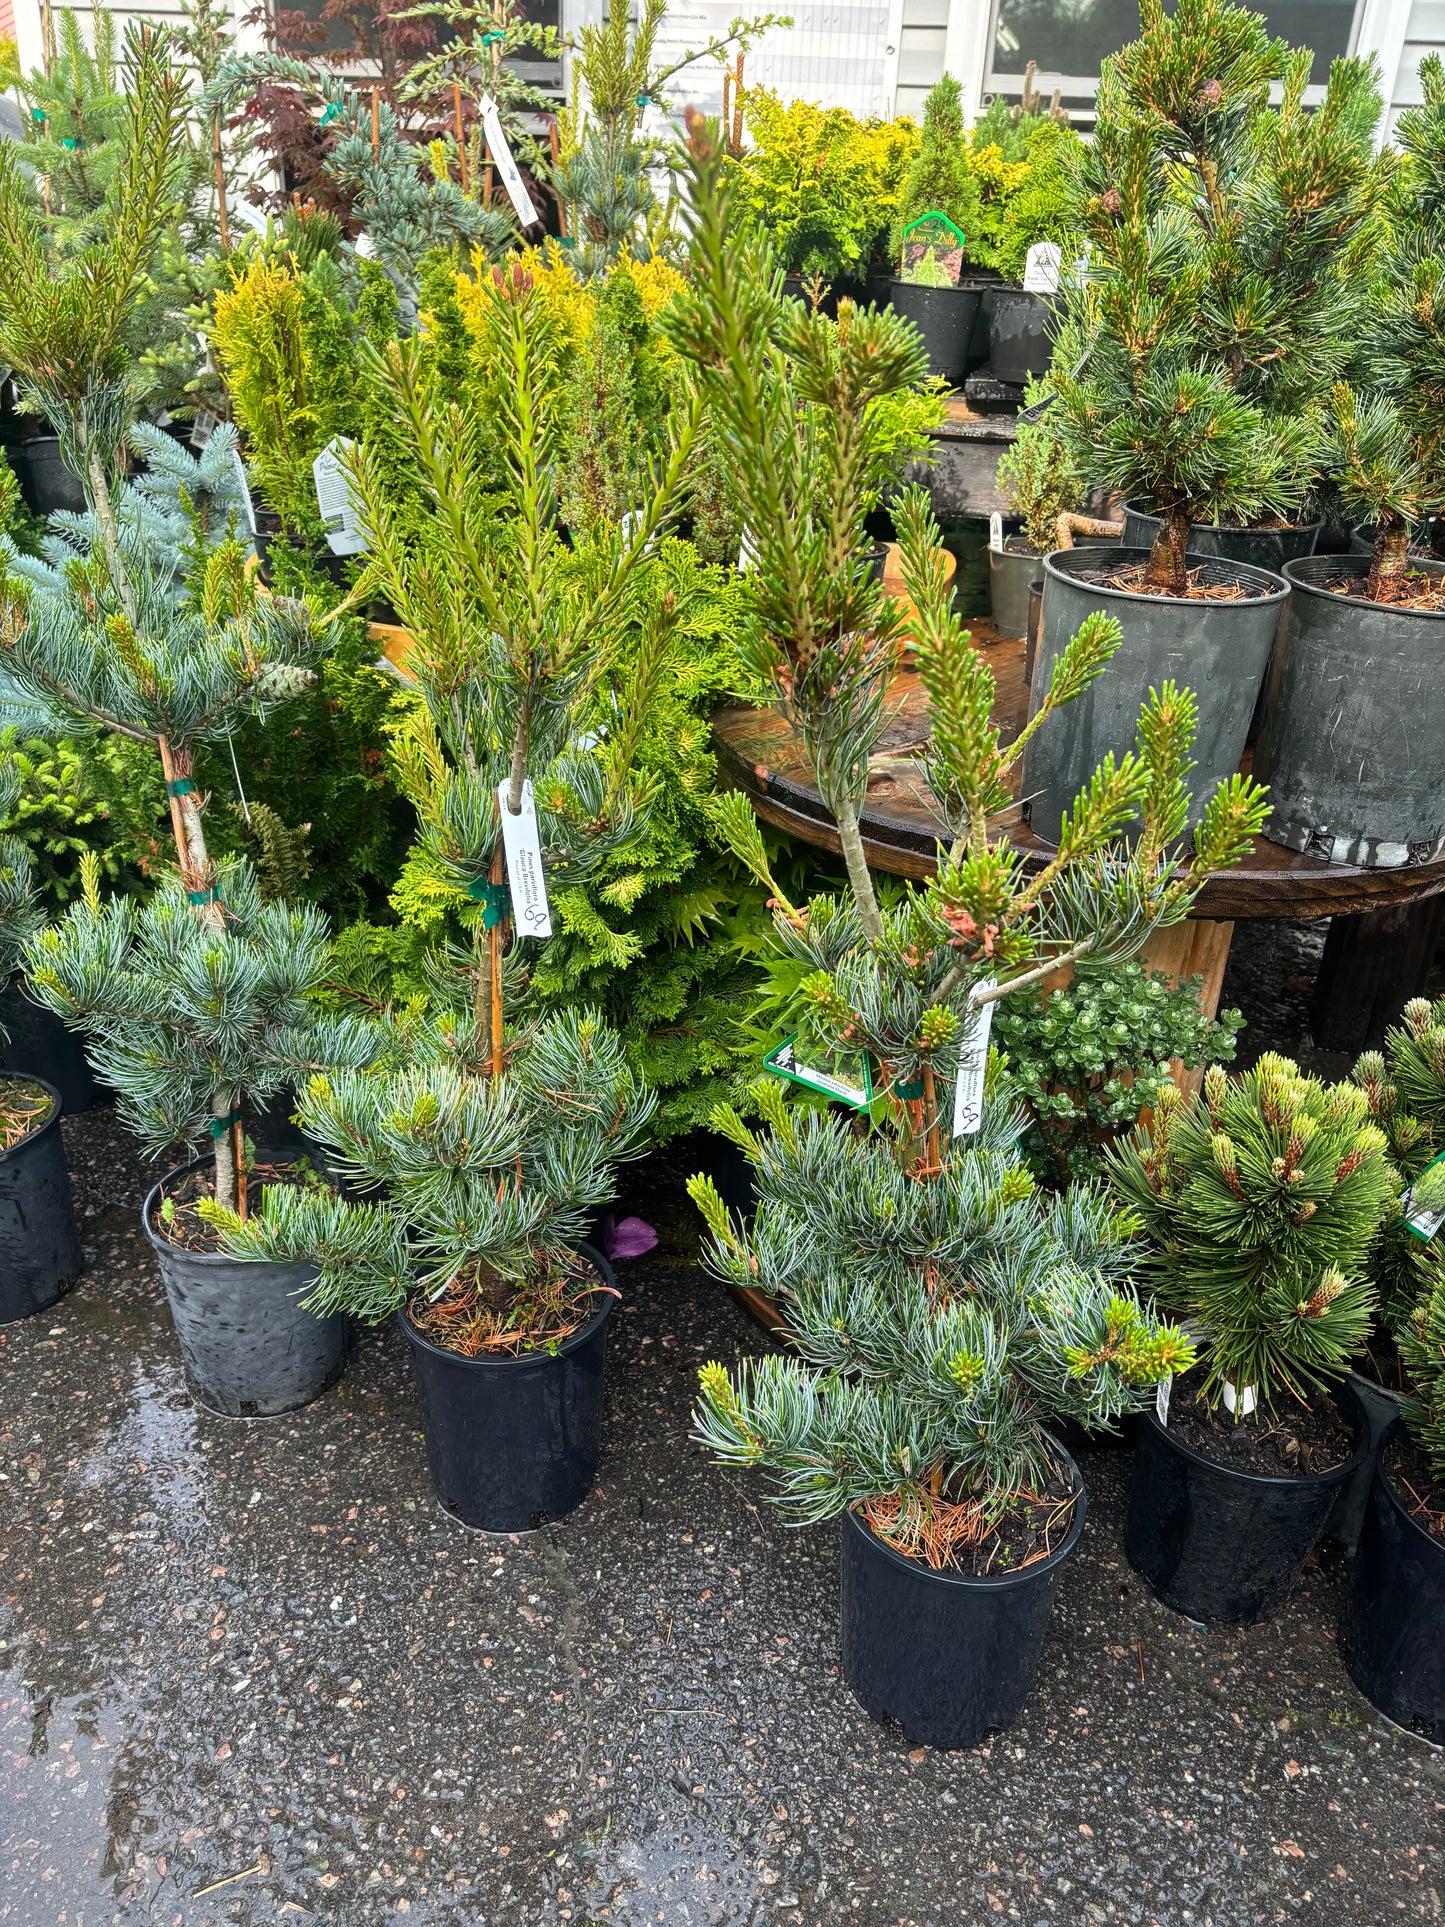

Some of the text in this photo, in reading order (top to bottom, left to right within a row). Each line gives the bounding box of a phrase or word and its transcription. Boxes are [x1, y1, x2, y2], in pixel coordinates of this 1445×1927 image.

[906, 228, 958, 248] Jean's Dilly
[529, 870, 539, 902] parviflora
[524, 904, 548, 930] 69
[962, 1102, 979, 1130] 69
